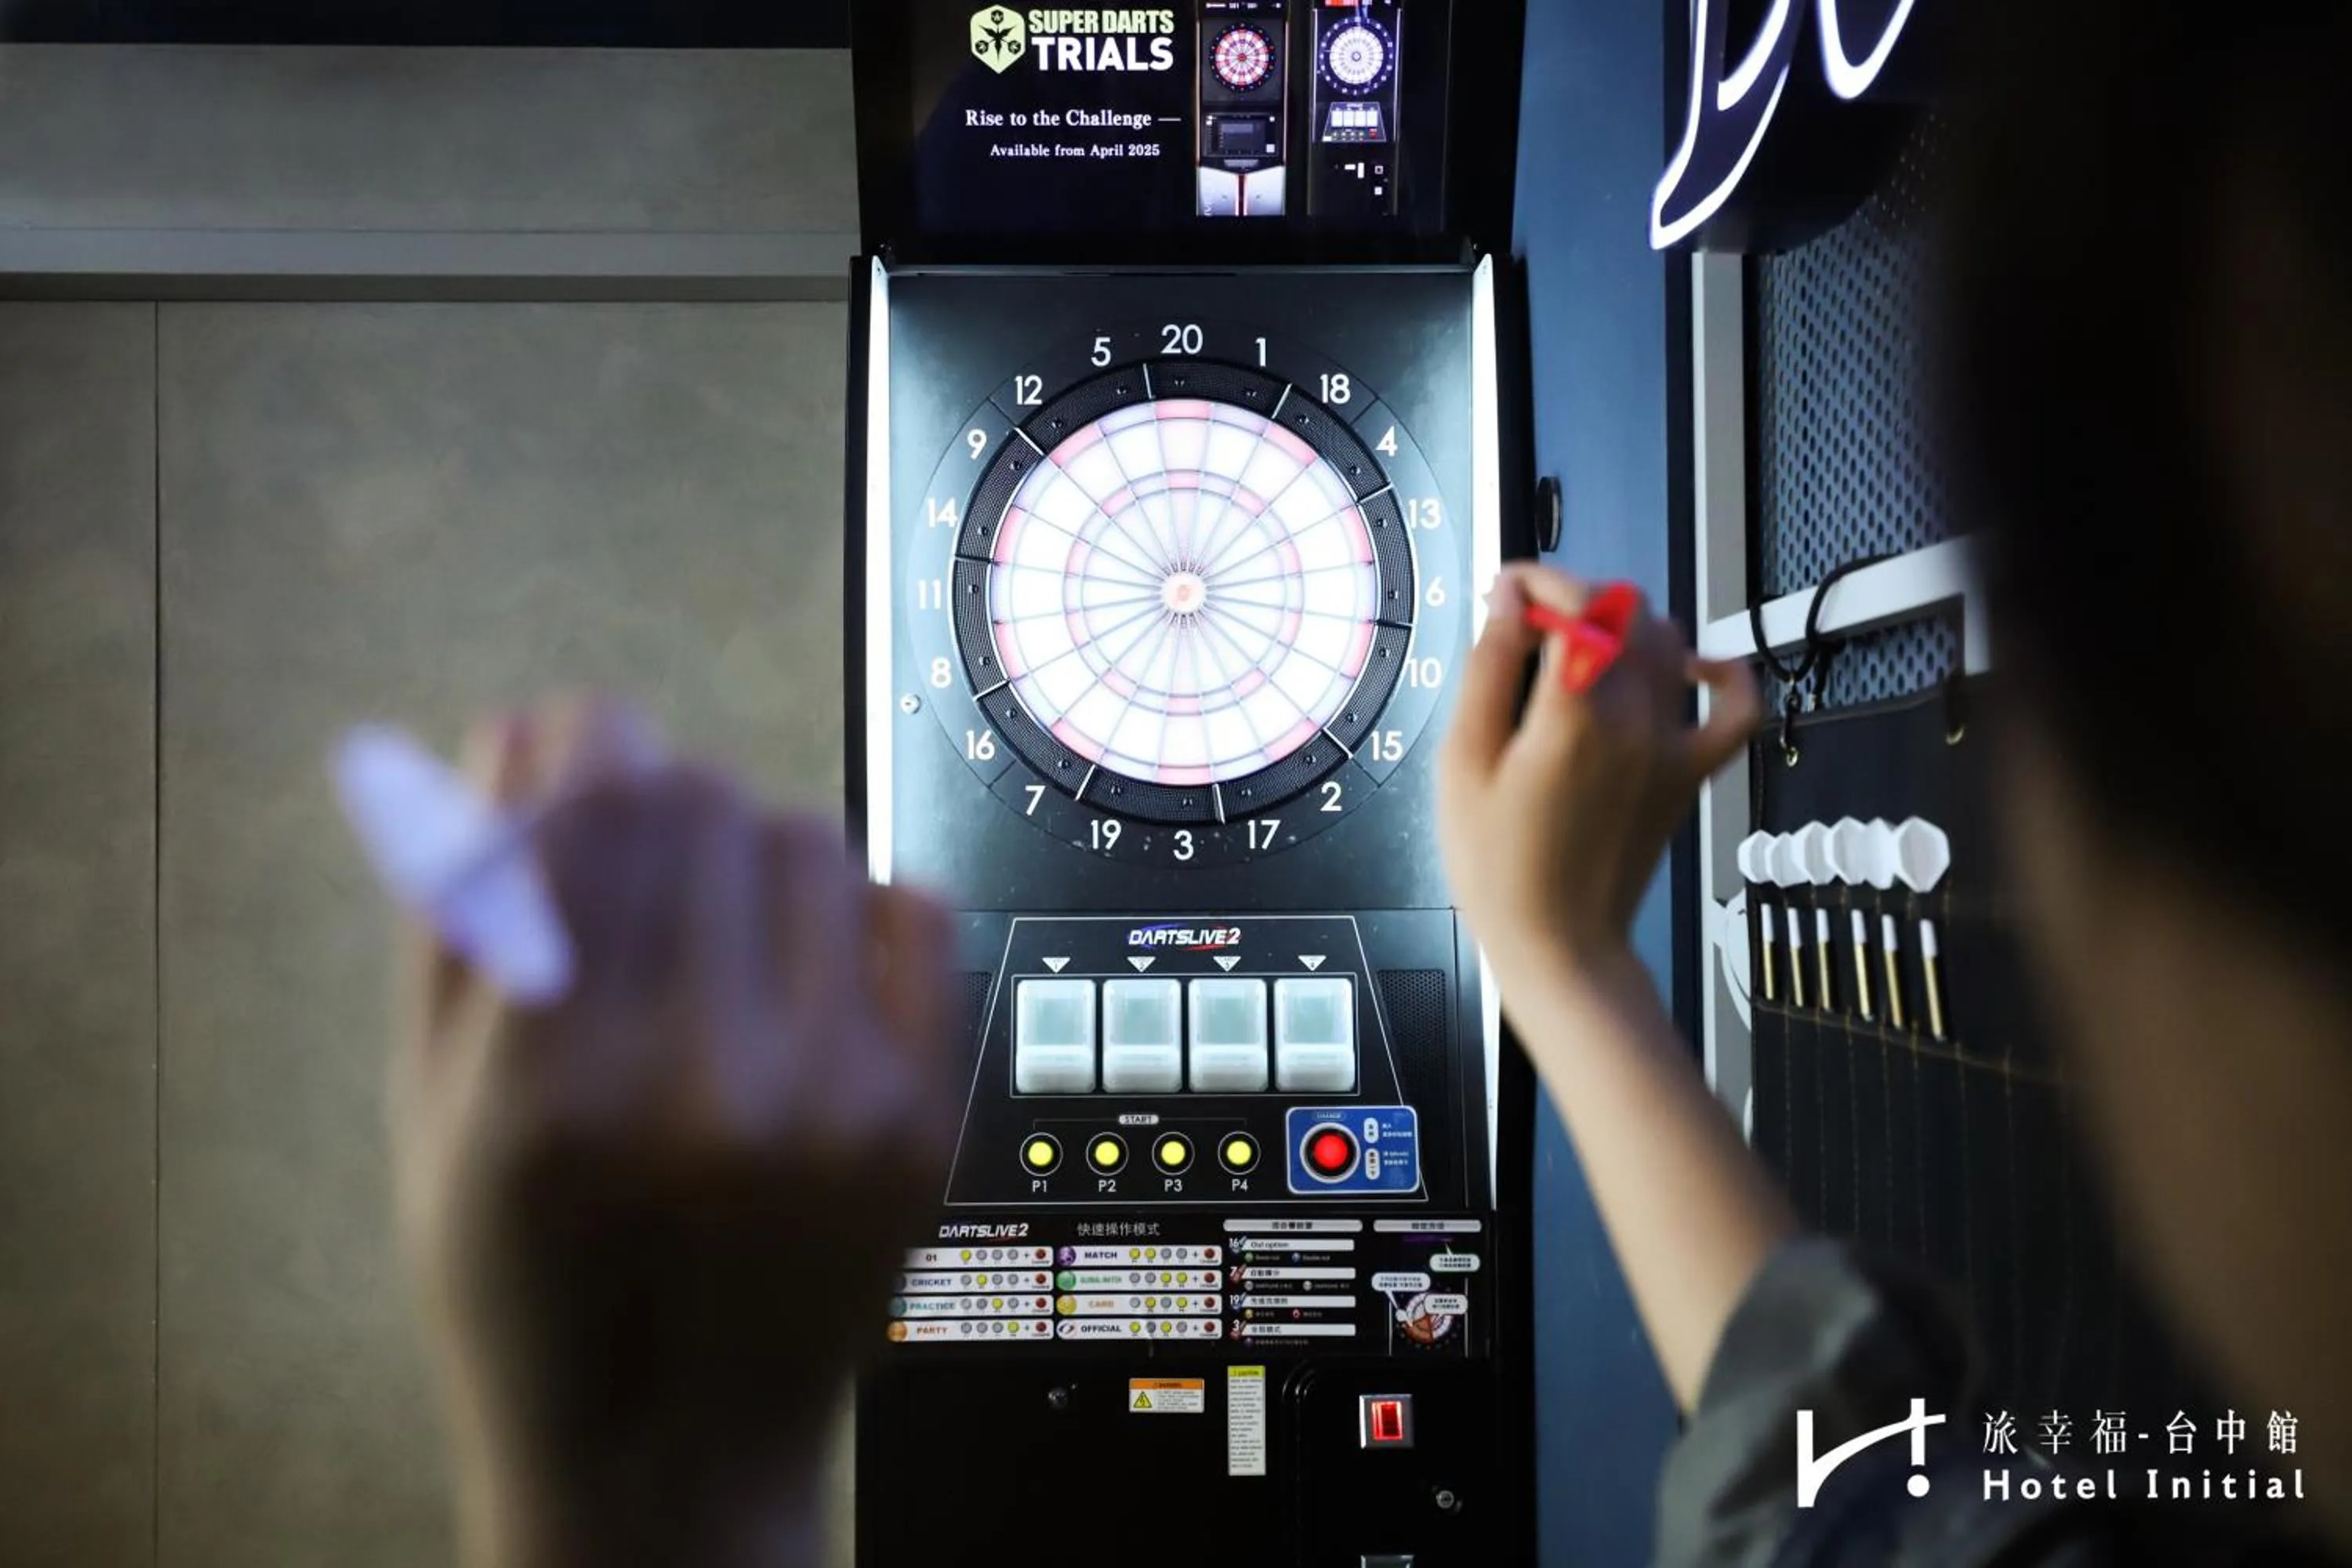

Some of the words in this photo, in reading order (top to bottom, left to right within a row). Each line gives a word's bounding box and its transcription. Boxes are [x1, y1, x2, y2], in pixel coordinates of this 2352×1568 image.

[1029, 9, 1098, 34] SUPER
[1102, 9, 1174, 34] DARTS
[1031, 37, 1174, 71] TRIALS
[965, 109, 1004, 126] Rise
[1010, 111, 1026, 126] to
[1033, 109, 1060, 126] the
[1065, 109, 1152, 129] Challenge
[990, 143, 1050, 157] Available
[1054, 143, 1085, 157] from
[1090, 143, 1123, 159] April
[1128, 144, 1160, 156] 2025
[1091, 338, 1112, 365] 5
[1161, 325, 1203, 354] 20
[1255, 339, 1266, 366] 1
[1014, 376, 1043, 405] 12
[1320, 374, 1351, 404] 18
[967, 430, 986, 459] 9
[1376, 427, 1398, 456] 4
[927, 499, 958, 528] 14
[1409, 499, 1441, 528] 13
[918, 580, 941, 609] 11
[1425, 577, 1446, 605] 6
[931, 659, 952, 687] 8
[1410, 659, 1443, 687] 10
[967, 731, 995, 760] 16
[1371, 731, 1403, 760] 15
[1025, 786, 1046, 815] 7
[1322, 783, 1342, 811] 2
[1091, 821, 1121, 849] 19
[1174, 832, 1194, 859] 3
[1247, 820, 1279, 848] 17
[1128, 927, 1241, 945] DARTSLIVE2
[1032, 1180, 1047, 1192] P1
[1098, 1180, 1116, 1192] P2
[1164, 1179, 1183, 1192] P3
[1232, 1179, 1248, 1192] P4
[1077, 1222, 1160, 1236] 快速操作模式
[909, 1301, 955, 1311] PRACTICE
[1080, 1325, 1122, 1334] OFFICIAL
